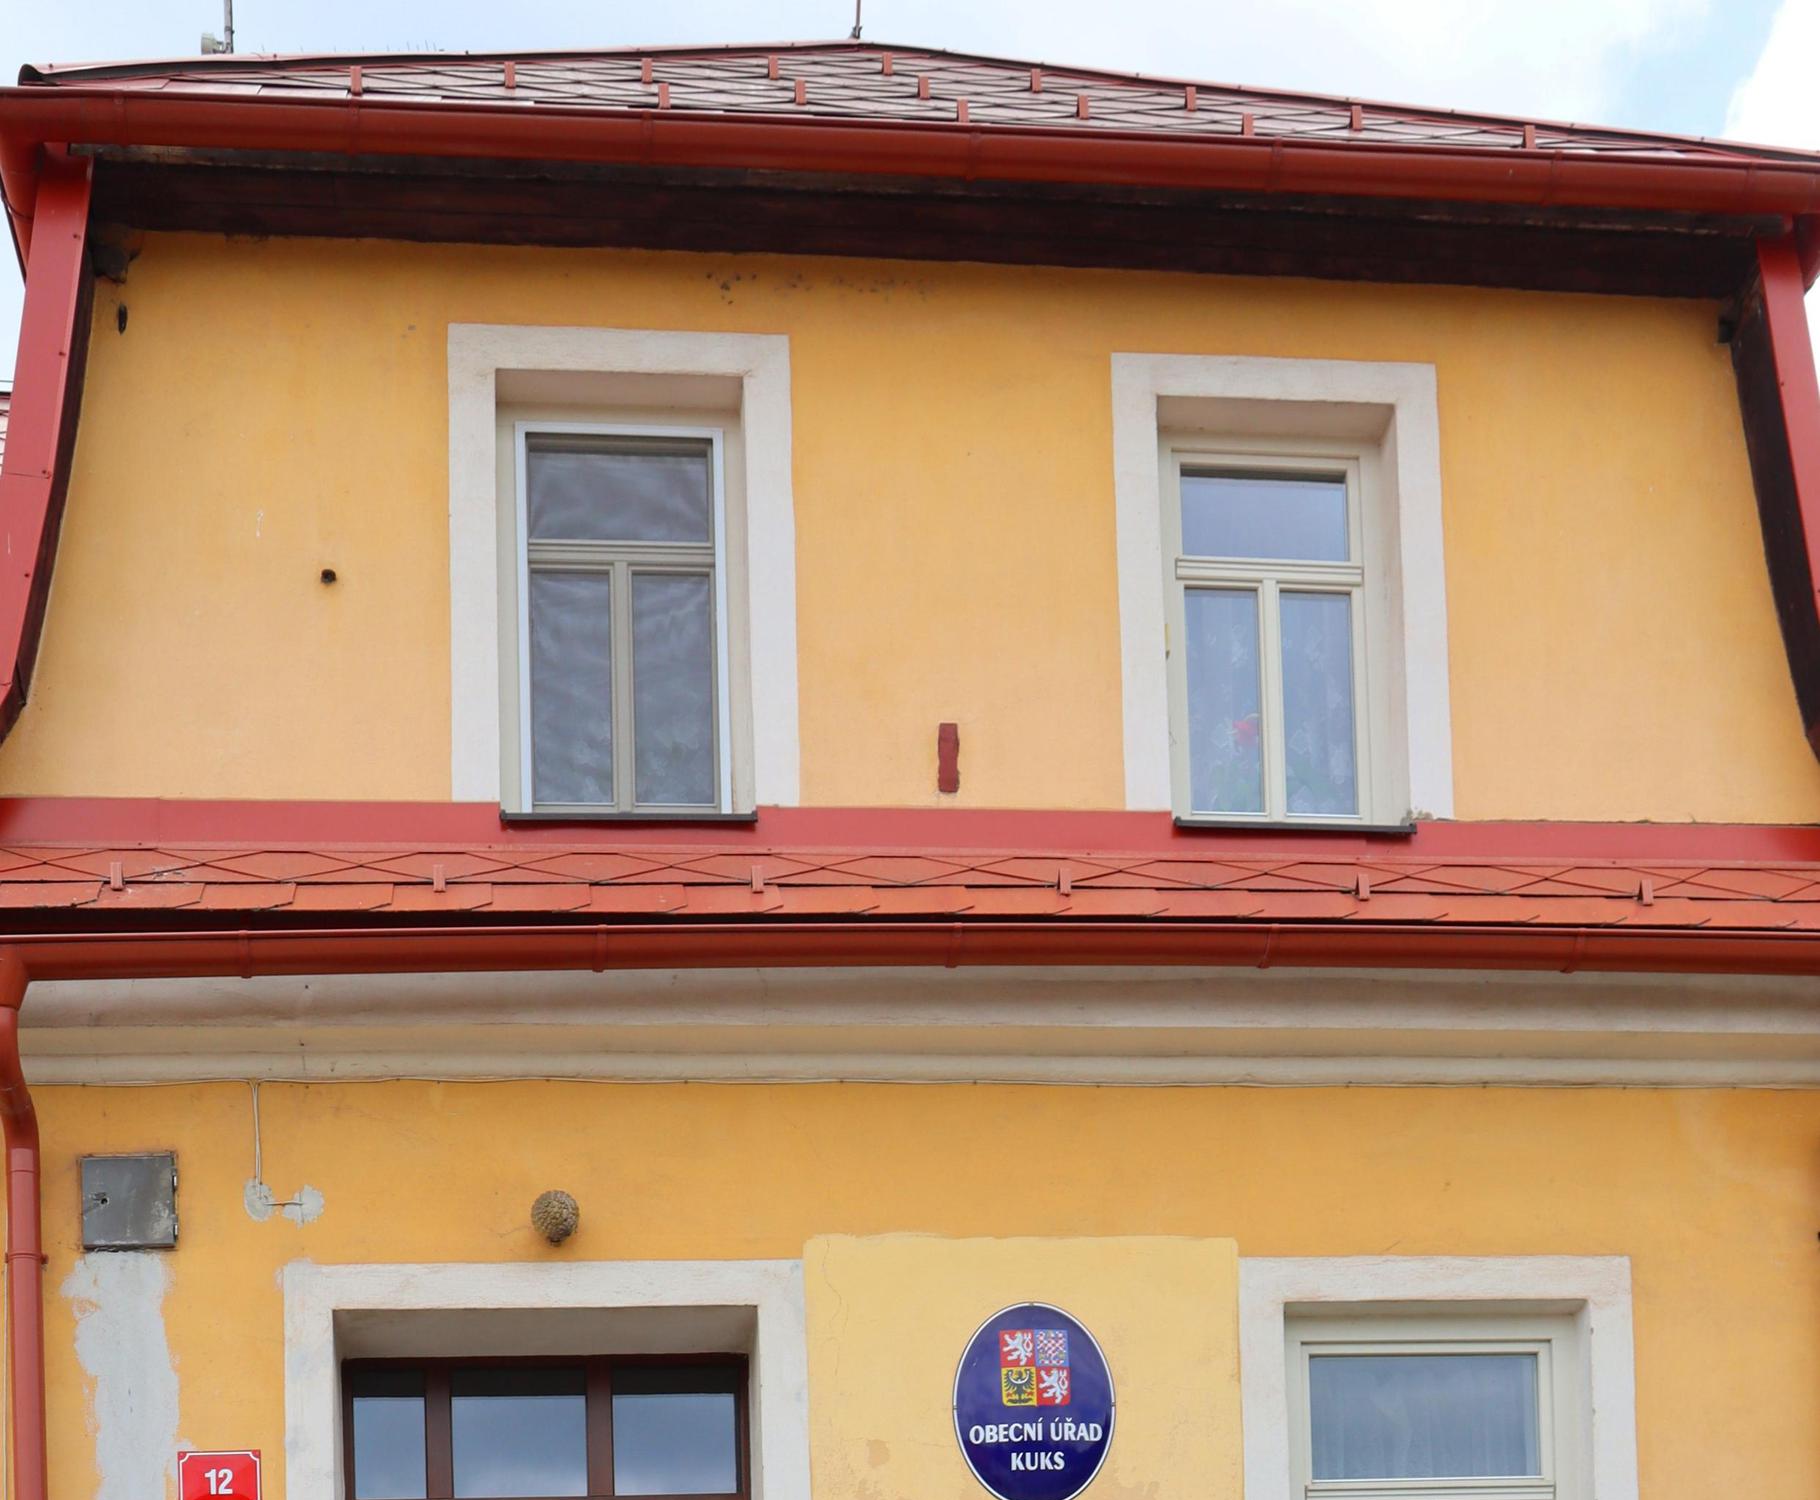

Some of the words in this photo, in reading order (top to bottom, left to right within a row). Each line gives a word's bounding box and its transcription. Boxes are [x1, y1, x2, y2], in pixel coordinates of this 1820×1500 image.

[969, 1417, 1043, 1444] OBECNÍ
[1050, 1417, 1103, 1442] ÚŘAD
[1011, 1451, 1065, 1471] KUKS
[204, 1468, 233, 1495] 12
